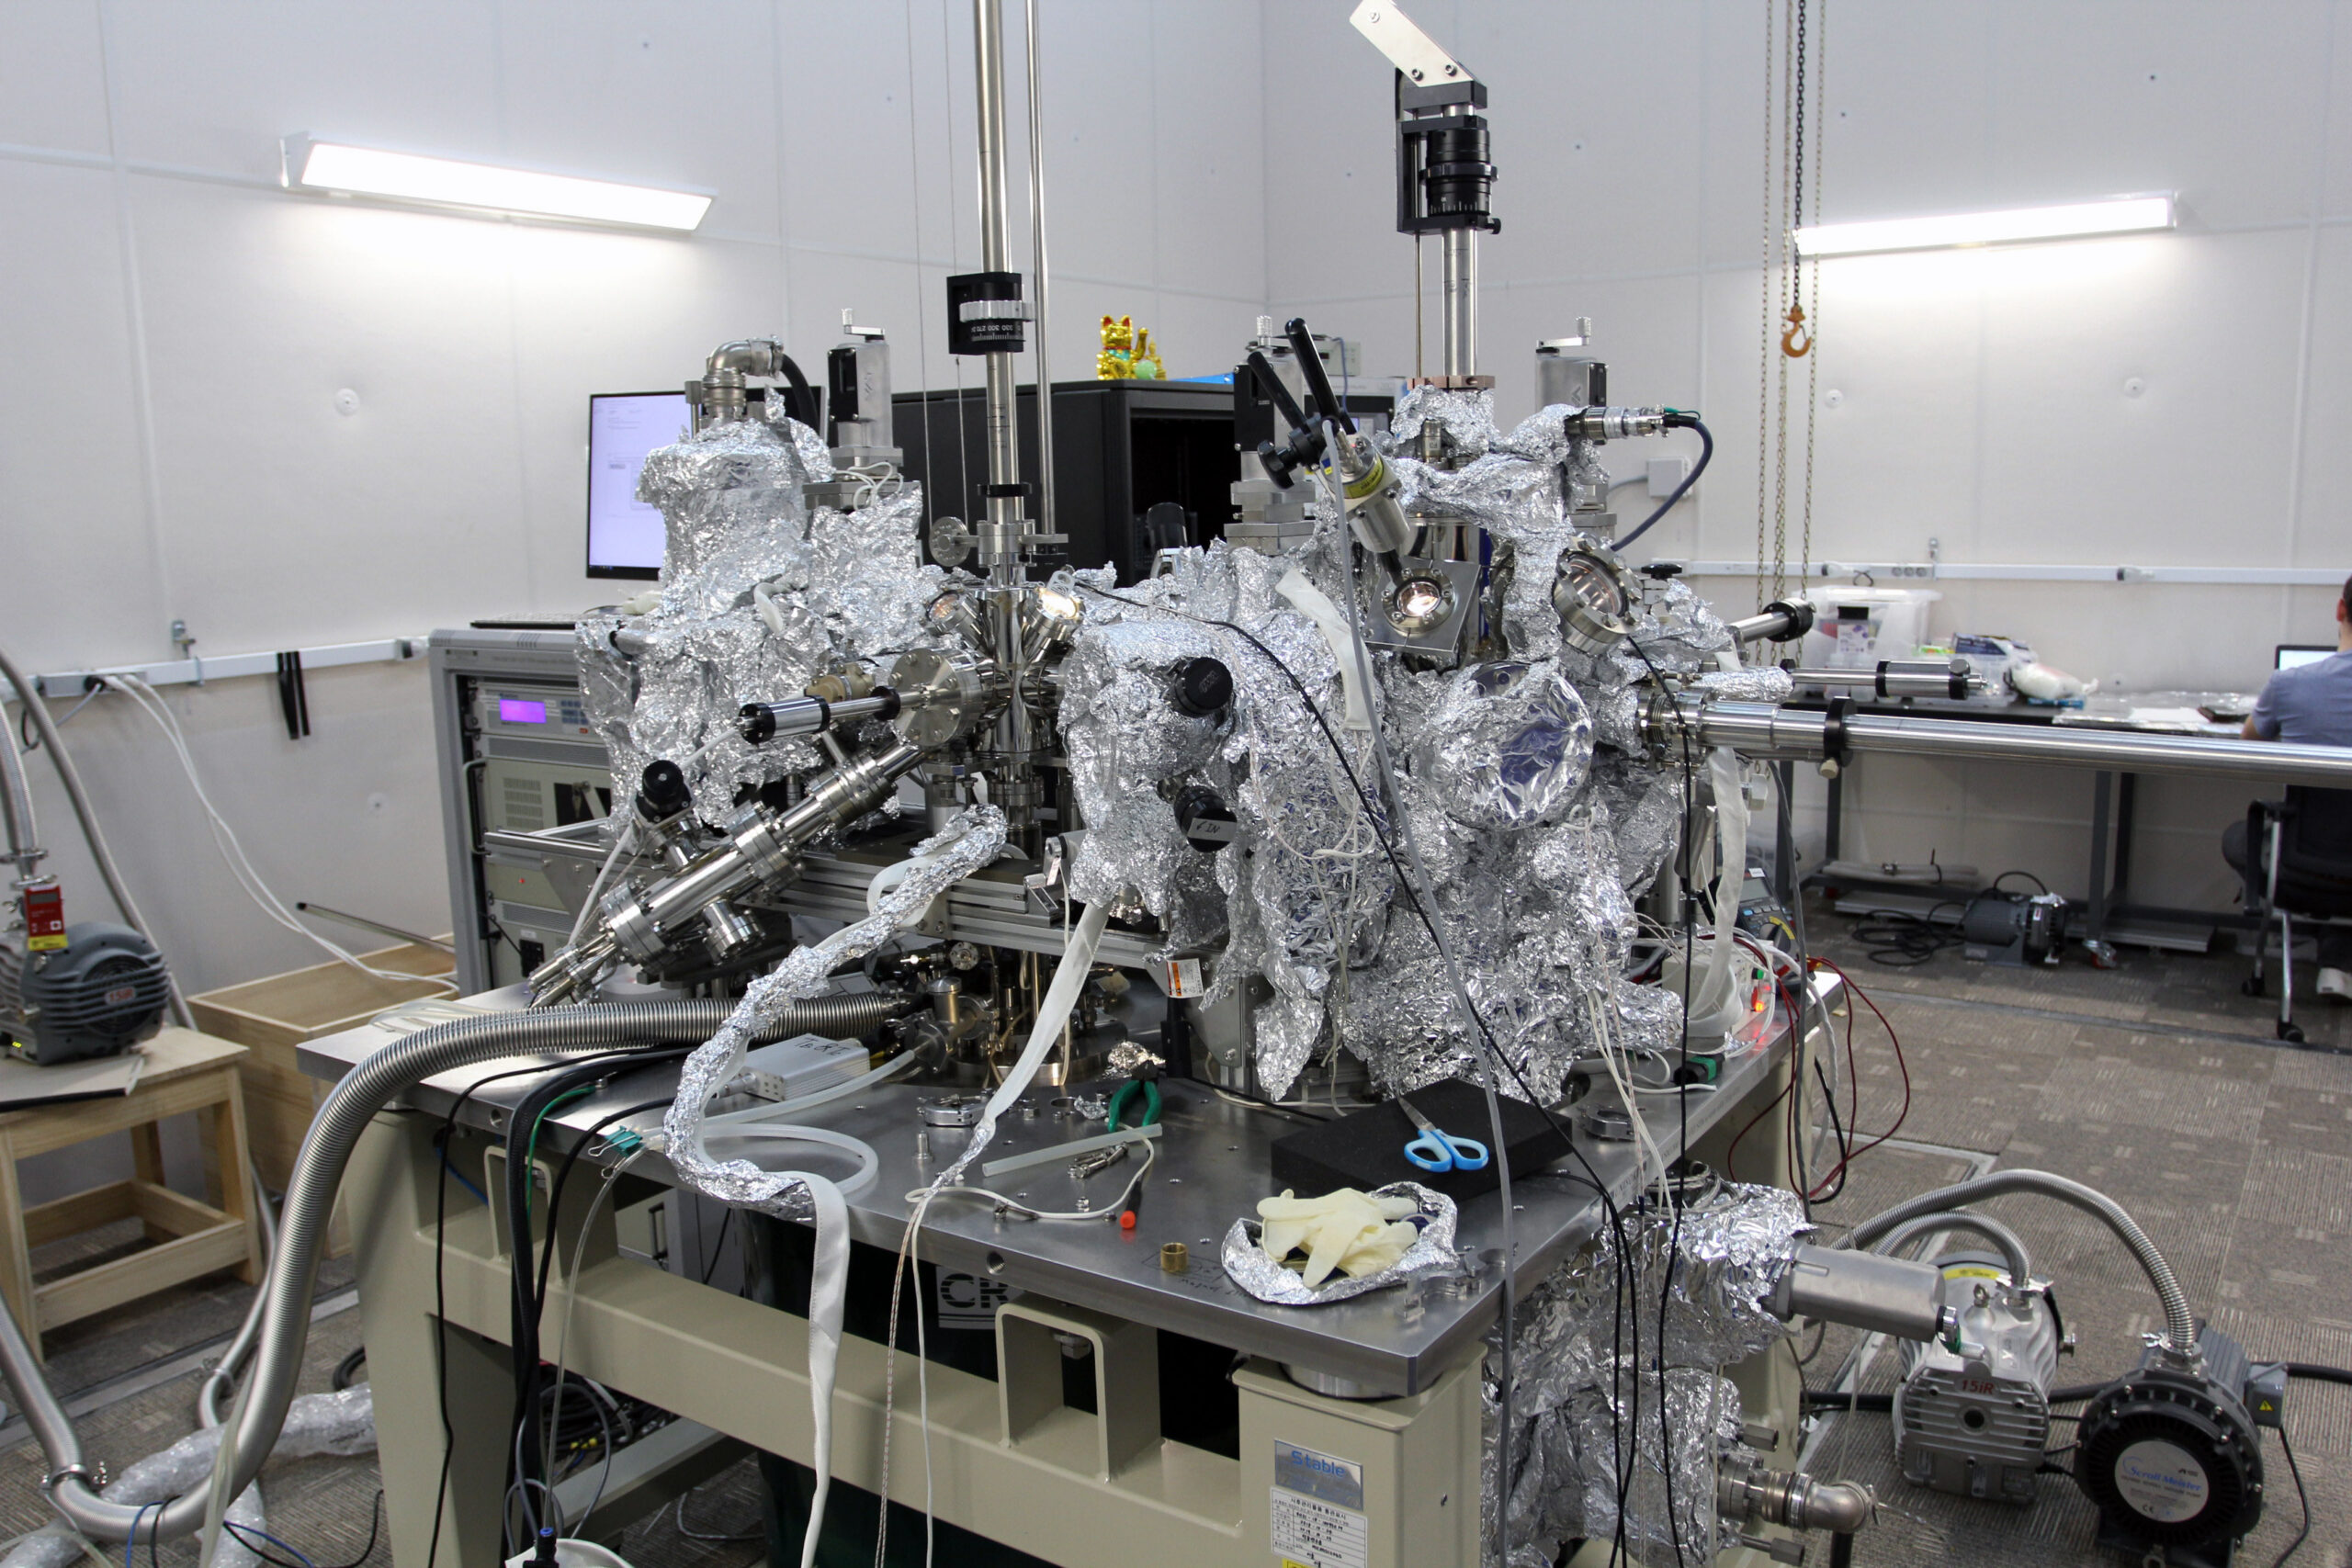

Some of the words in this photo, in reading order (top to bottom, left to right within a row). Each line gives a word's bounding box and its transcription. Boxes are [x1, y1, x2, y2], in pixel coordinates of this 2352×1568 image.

[1290, 1450, 1346, 1478] Stable
[2127, 1464, 2161, 1481] Scroll
[2163, 1474, 2202, 1491] Meister
